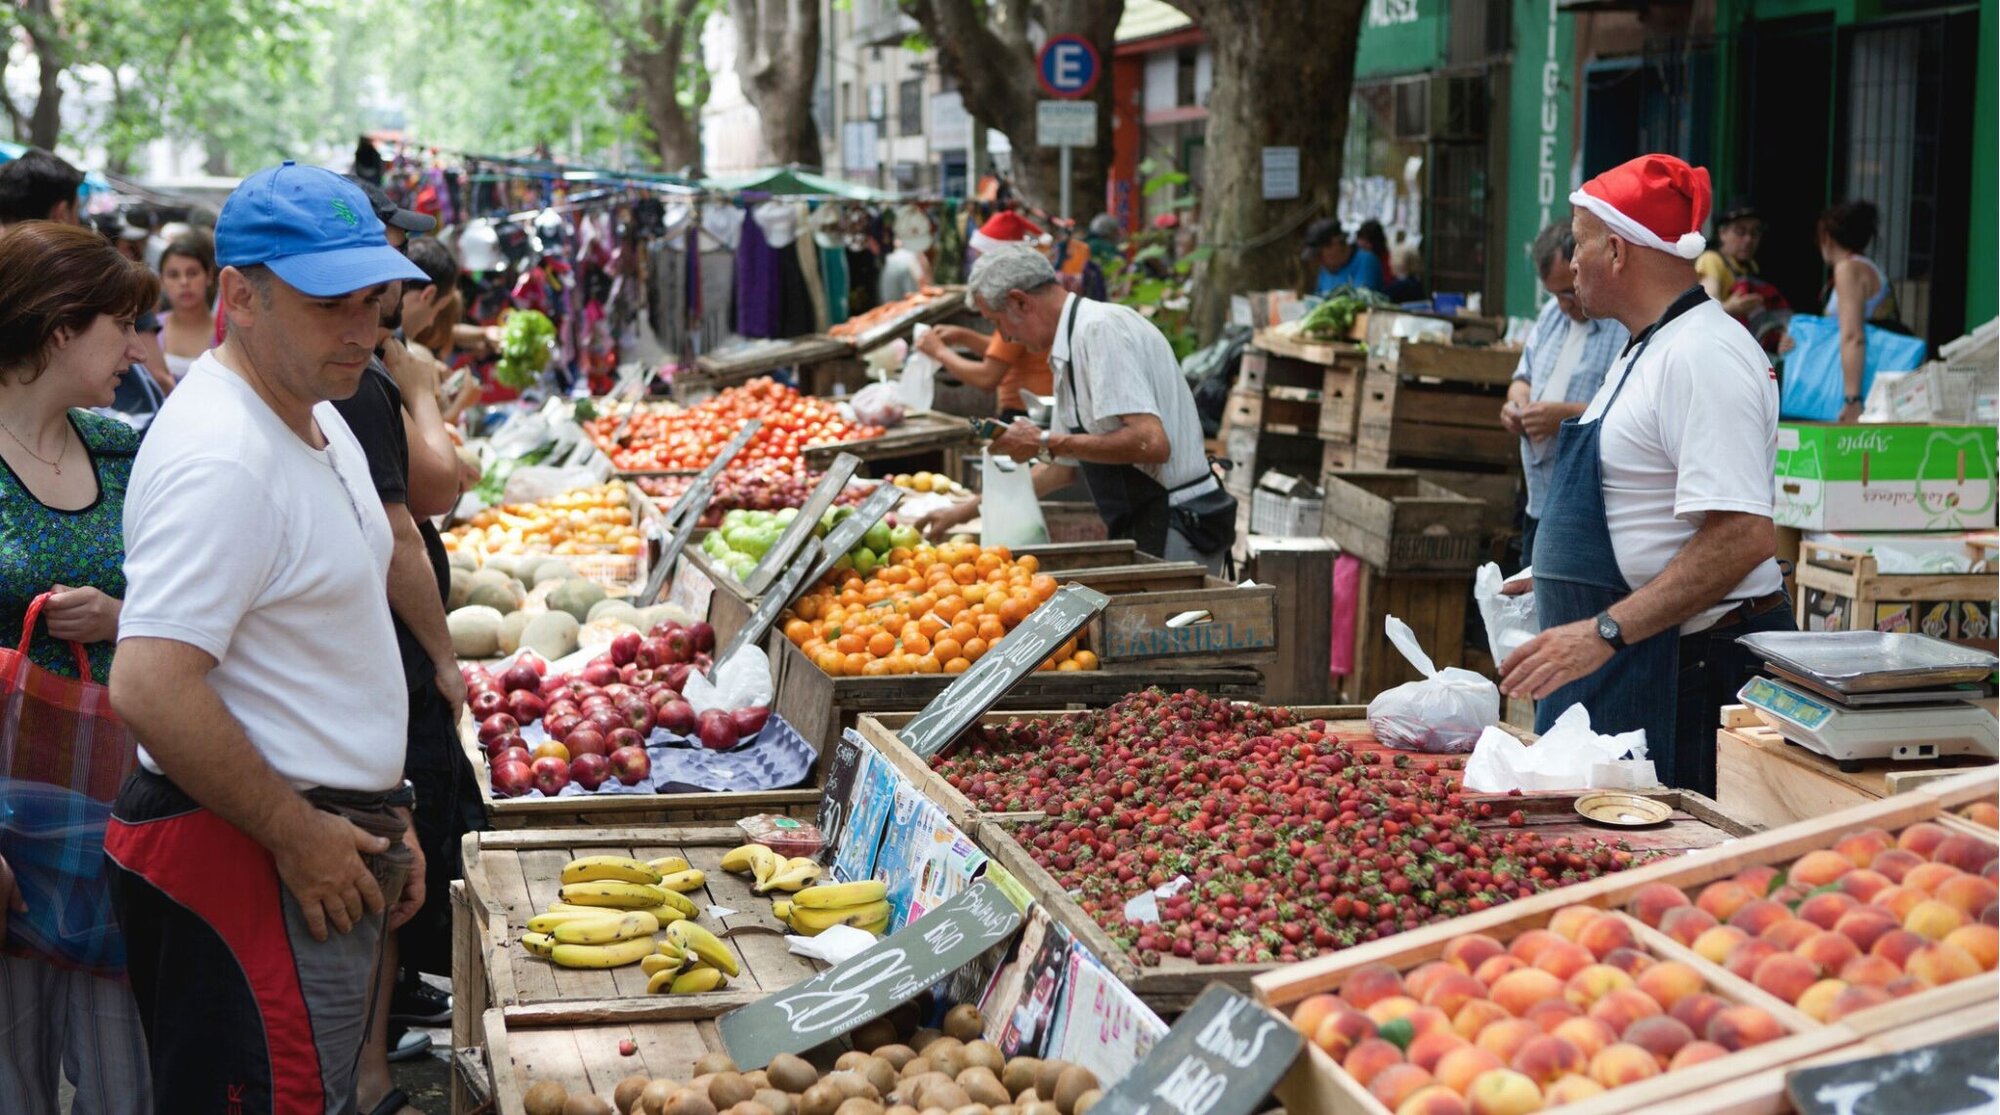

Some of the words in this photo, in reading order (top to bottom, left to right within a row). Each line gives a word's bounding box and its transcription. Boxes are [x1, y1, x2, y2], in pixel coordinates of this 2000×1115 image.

[1055, 44, 1082, 88] E
[1837, 429, 1893, 455] Apple
[948, 883, 1019, 937] BANANAS
